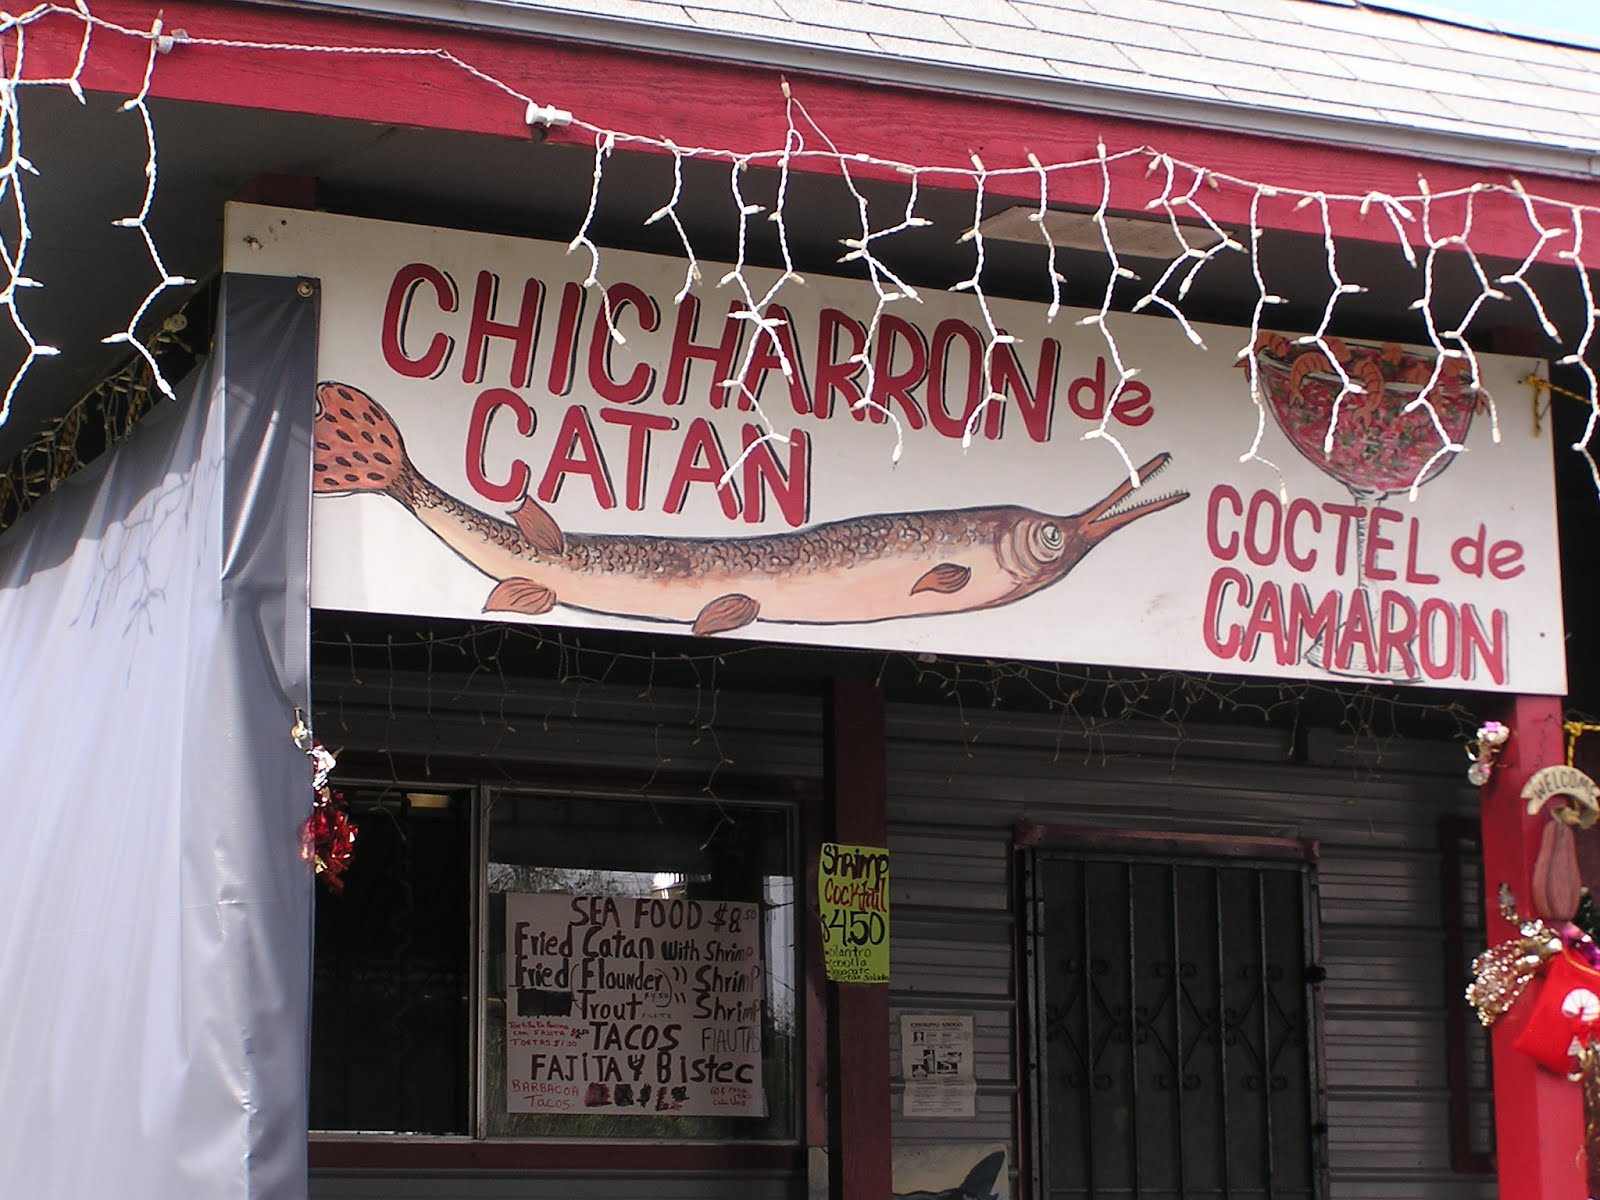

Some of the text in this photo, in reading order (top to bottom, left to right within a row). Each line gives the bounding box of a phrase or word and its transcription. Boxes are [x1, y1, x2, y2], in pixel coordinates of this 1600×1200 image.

[381, 262, 1155, 443] CHICHARRON de
[465, 387, 812, 528] CATAN
[1206, 484, 1526, 585] COCTEL de
[1203, 567, 1510, 686] CAMARON
[514, 921, 573, 958] Fried
[582, 926, 654, 960] Catan
[569, 896, 621, 928] SEA
[634, 898, 703, 930] FOOD
[509, 955, 569, 988] Fried
[589, 1021, 682, 1051] TACOS
